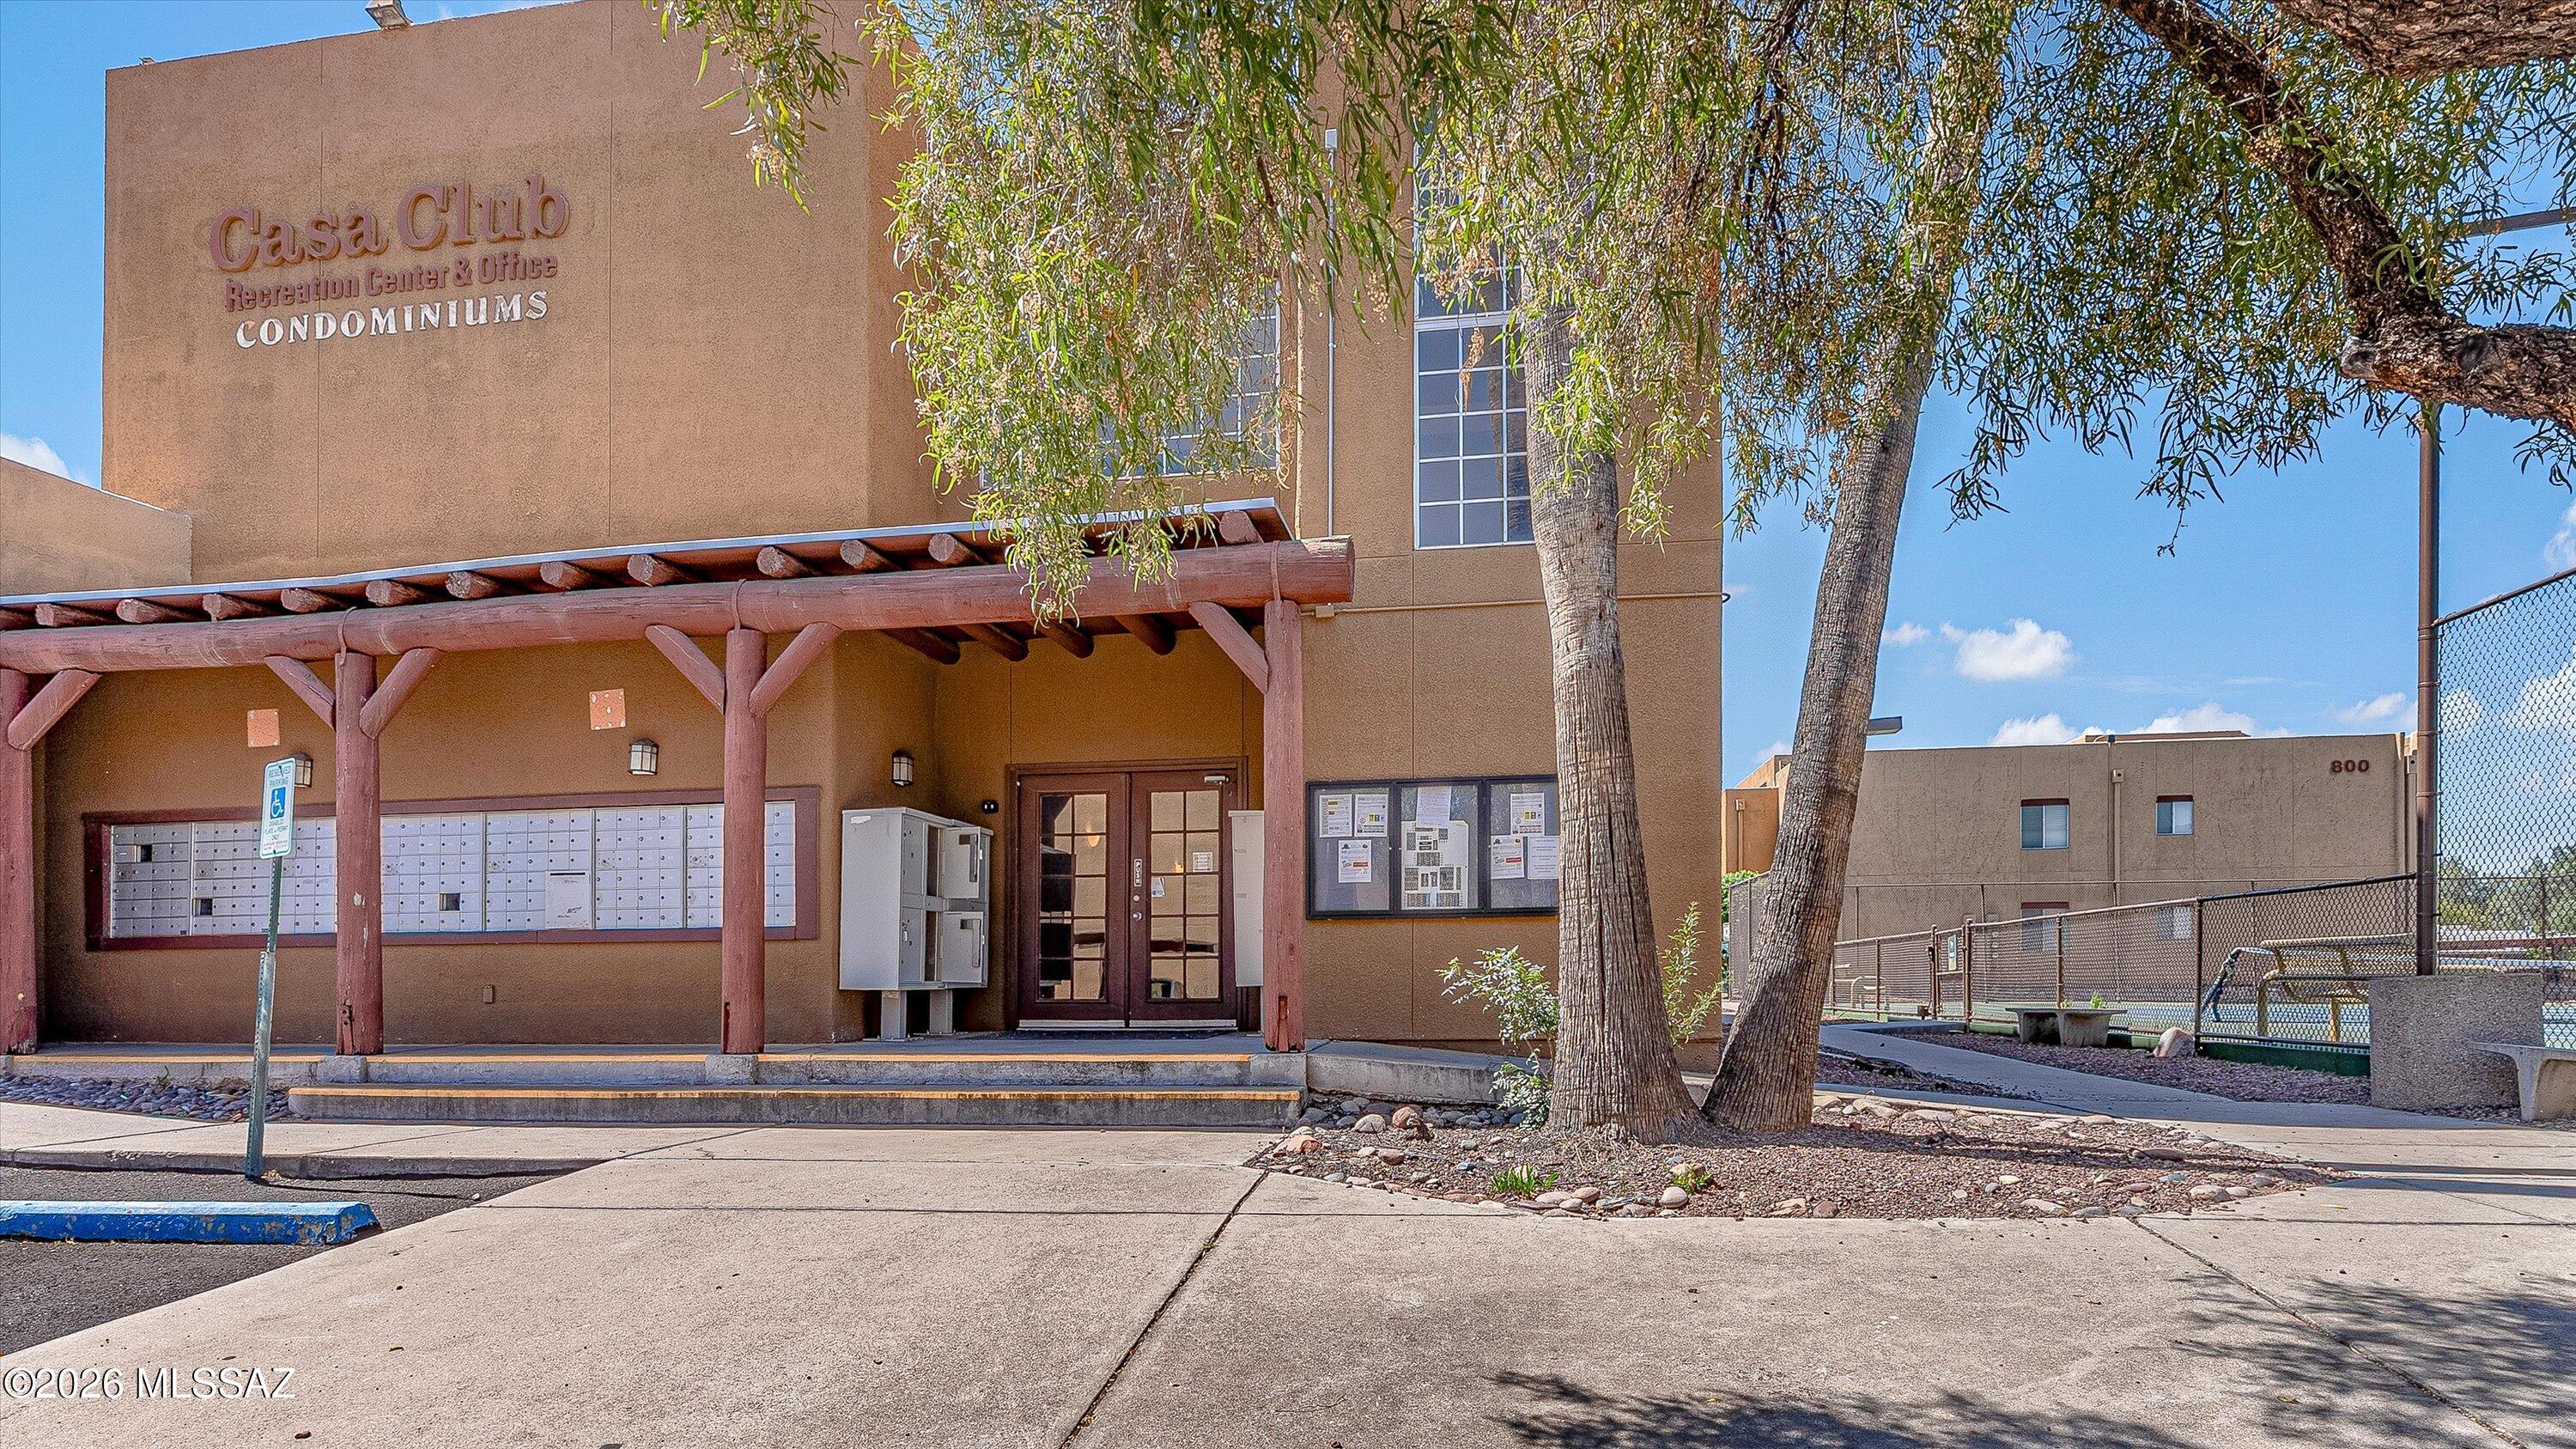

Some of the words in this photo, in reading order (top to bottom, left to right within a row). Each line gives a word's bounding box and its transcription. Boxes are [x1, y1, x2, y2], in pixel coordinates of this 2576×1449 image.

[209, 203, 389, 274] Casa
[396, 172, 570, 252] Club
[225, 272, 360, 313] Recreation
[364, 264, 449, 296] Center
[447, 259, 473, 287] &
[477, 249, 559, 283] Office
[235, 289, 550, 350] CONDOMINIUMS
[270, 776, 289, 787] PARKING
[2330, 759, 2370, 773] 800
